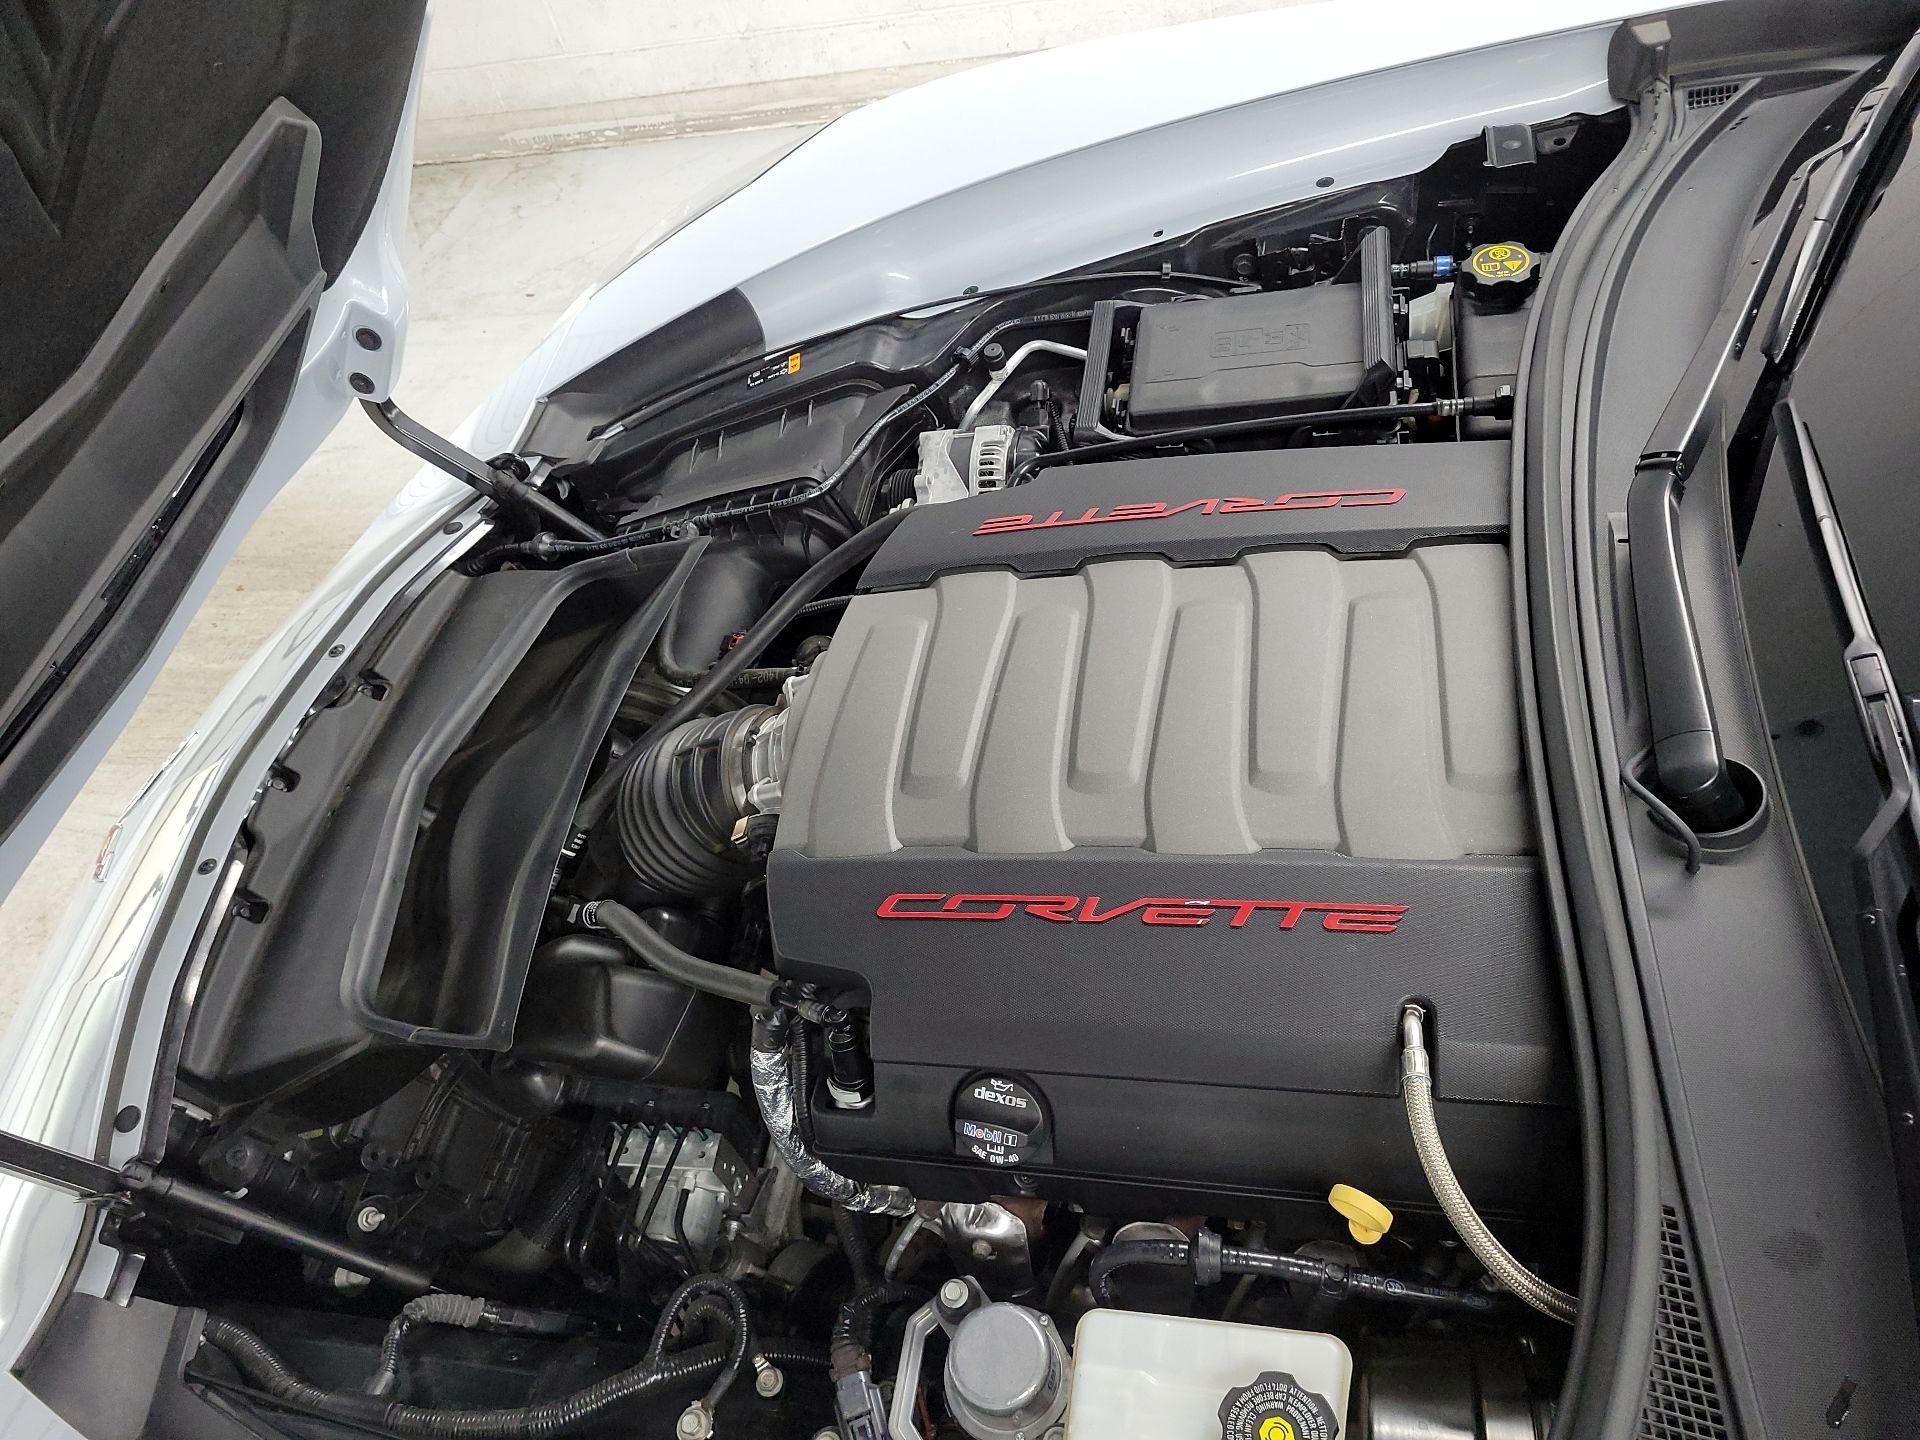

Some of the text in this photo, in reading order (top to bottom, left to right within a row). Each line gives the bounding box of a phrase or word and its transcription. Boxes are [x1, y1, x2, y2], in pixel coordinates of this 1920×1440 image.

[972, 488, 1406, 536] CORVETTE
[876, 893, 1410, 933] CORVETTE
[974, 1086, 1028, 1109] dexos
[963, 1122, 1018, 1147] Mobil 1
[971, 1144, 1020, 1164] SAE 0W-40
[1241, 1388, 1255, 1404] FROM
[1252, 1391, 1275, 1407] BEFORE
[1254, 1382, 1272, 1394] FLUID
[1275, 1392, 1287, 1401] CAP
[1226, 1405, 1240, 1431] SEALED
[1244, 1411, 1257, 1432] CLEAN
[1286, 1405, 1311, 1439] PROVENANT
